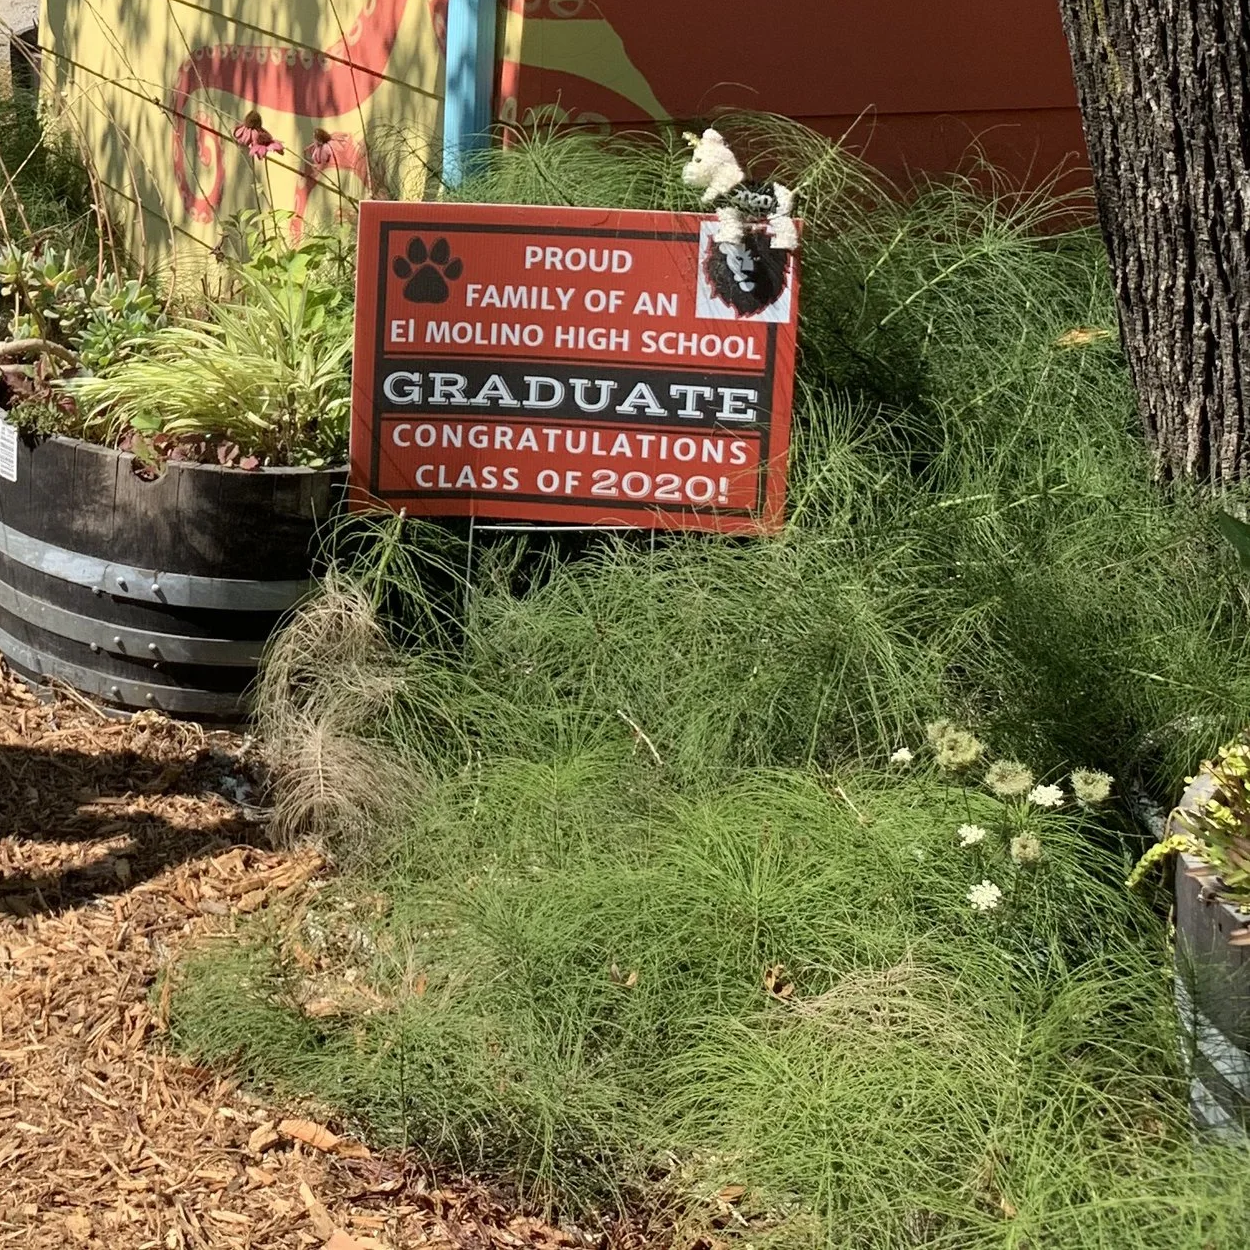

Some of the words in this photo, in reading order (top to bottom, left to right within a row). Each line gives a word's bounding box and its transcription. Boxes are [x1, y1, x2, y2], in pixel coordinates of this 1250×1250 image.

[524, 245, 633, 274] PROUD
[466, 283, 576, 312] FAMILY
[584, 288, 626, 314] OF
[632, 293, 678, 317] AN
[425, 320, 545, 348] MOLINO
[555, 325, 630, 353] HIGH
[641, 330, 762, 360] SCHOOL
[382, 370, 759, 422] GRADUATE
[392, 423, 748, 465] CONGRATULATIONS
[415, 464, 520, 490] CLASS
[536, 469, 583, 495] OF
[591, 468, 730, 504] 2020!
